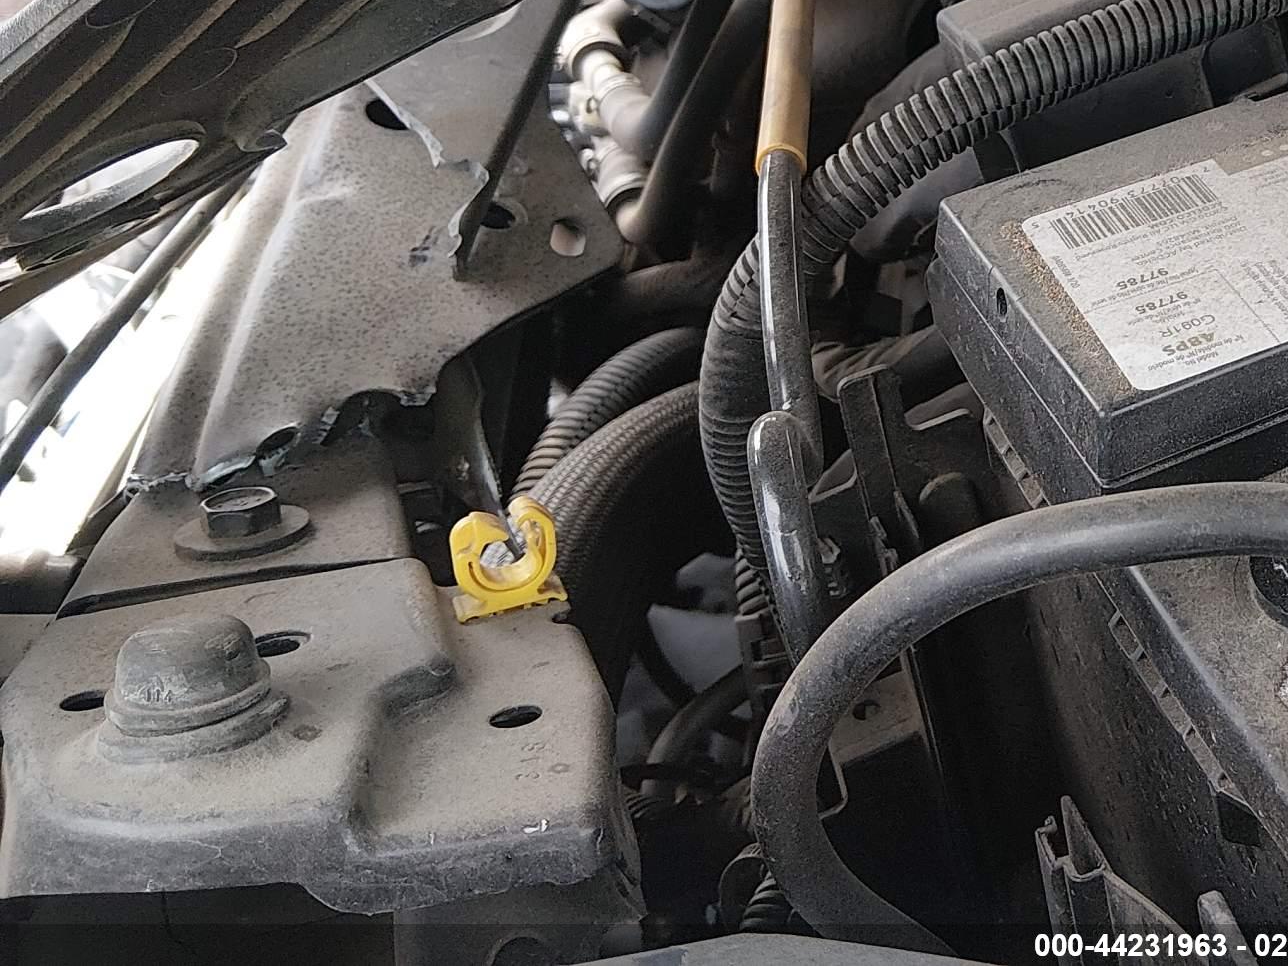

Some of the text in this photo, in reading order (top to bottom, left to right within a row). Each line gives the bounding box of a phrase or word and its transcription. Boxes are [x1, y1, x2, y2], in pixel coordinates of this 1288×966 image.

[1124, 175, 1182, 197] 07773
[1063, 196, 1120, 217] 90414
[1135, 249, 1179, 266] ACDelco
[1114, 266, 1169, 290] 97785
[1133, 290, 1189, 314] 97785
[1157, 312, 1217, 339] G091R
[1159, 329, 1218, 357] 48PS
[1146, 357, 1175, 371] modelo
[1195, 350, 1219, 362] Model
